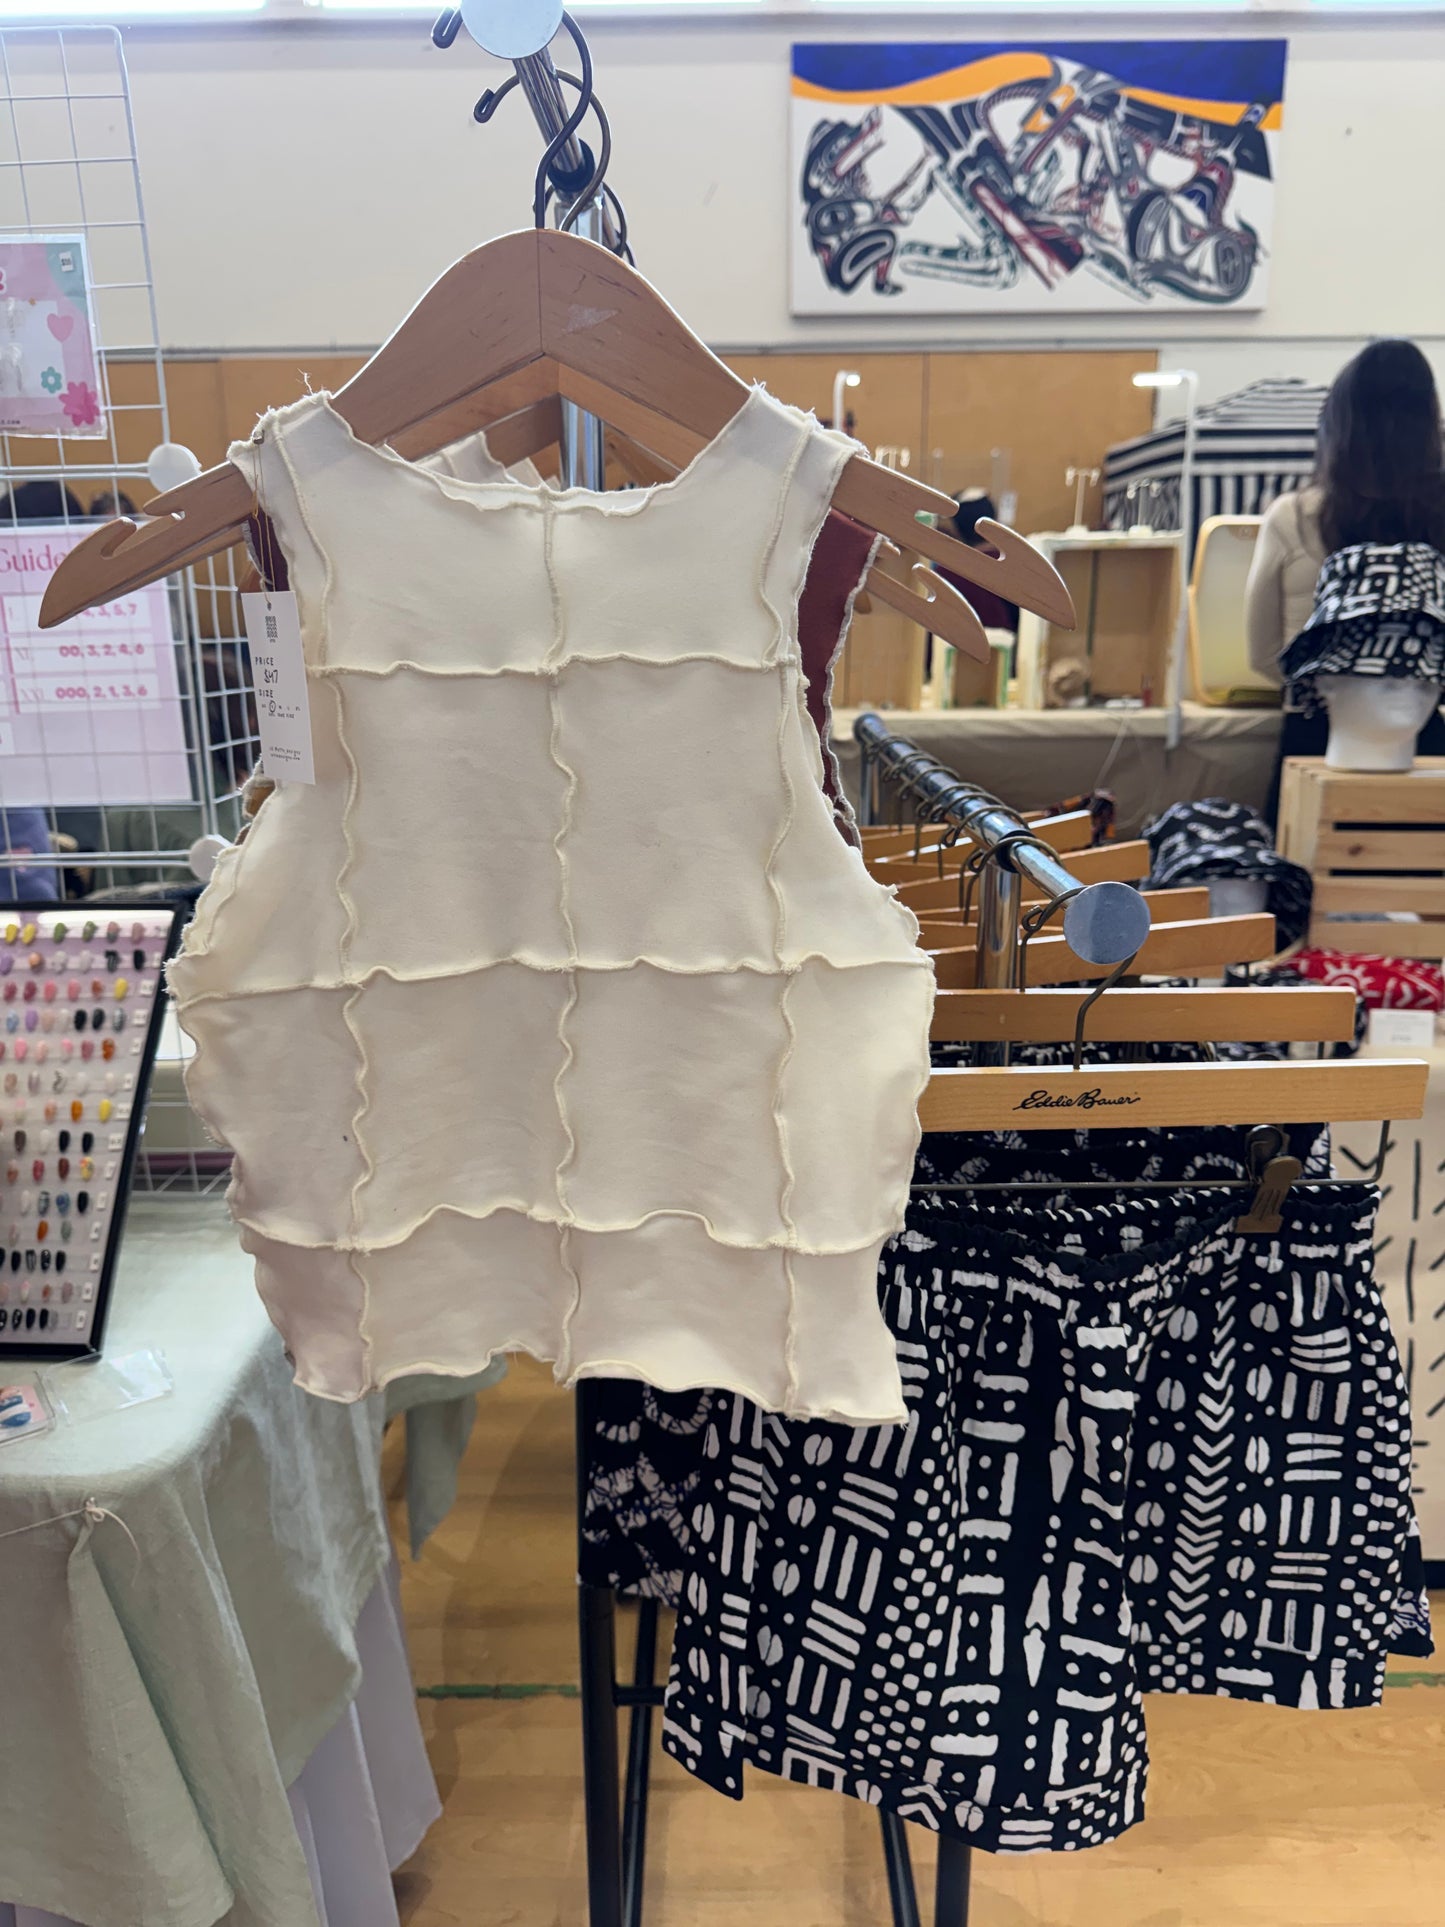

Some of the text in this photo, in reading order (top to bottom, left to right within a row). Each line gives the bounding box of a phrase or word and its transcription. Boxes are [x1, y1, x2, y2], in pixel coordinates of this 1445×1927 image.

[255, 656, 274, 666] PRICE
[258, 689, 274, 698] SIZE
[1012, 1088, 1141, 1110] Eddie Bauer
